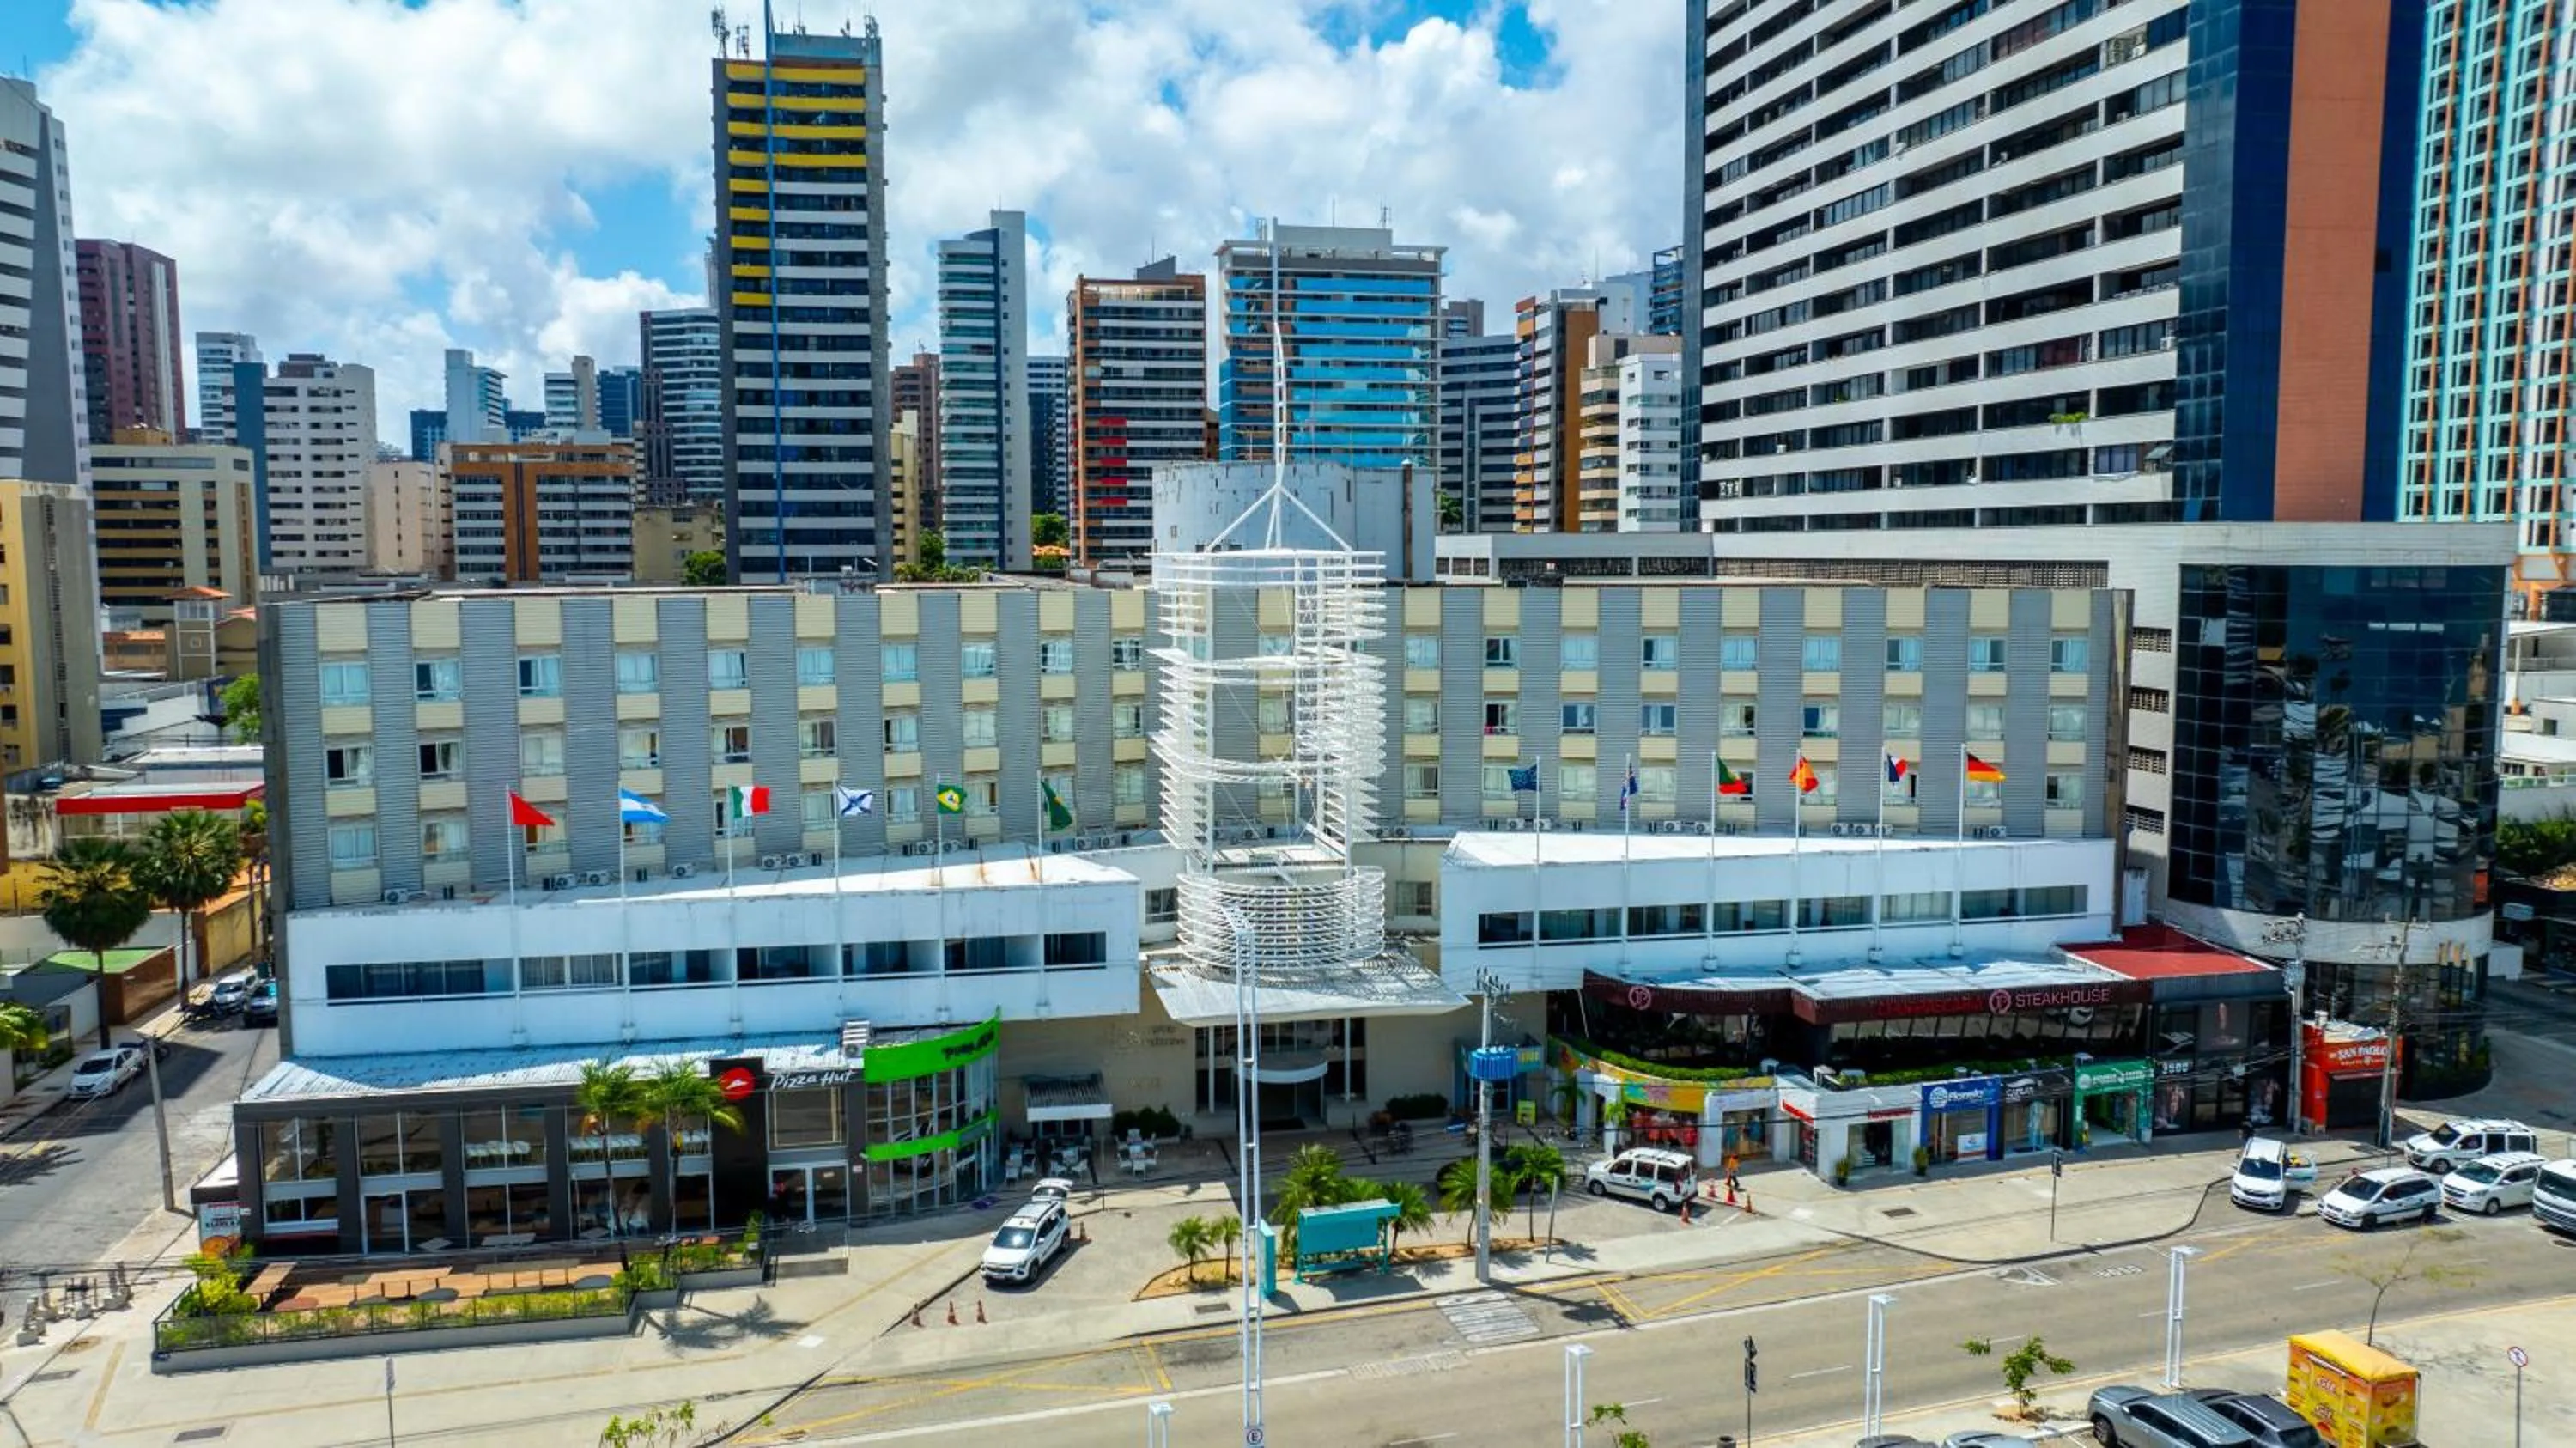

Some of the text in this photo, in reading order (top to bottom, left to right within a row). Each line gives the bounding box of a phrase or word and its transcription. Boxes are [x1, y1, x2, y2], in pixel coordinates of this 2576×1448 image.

[2015, 989, 2110, 1007] STEAKHOUSE
[770, 1071, 854, 1091] Pizza Hut
[1251, 1432, 1259, 1442] E
